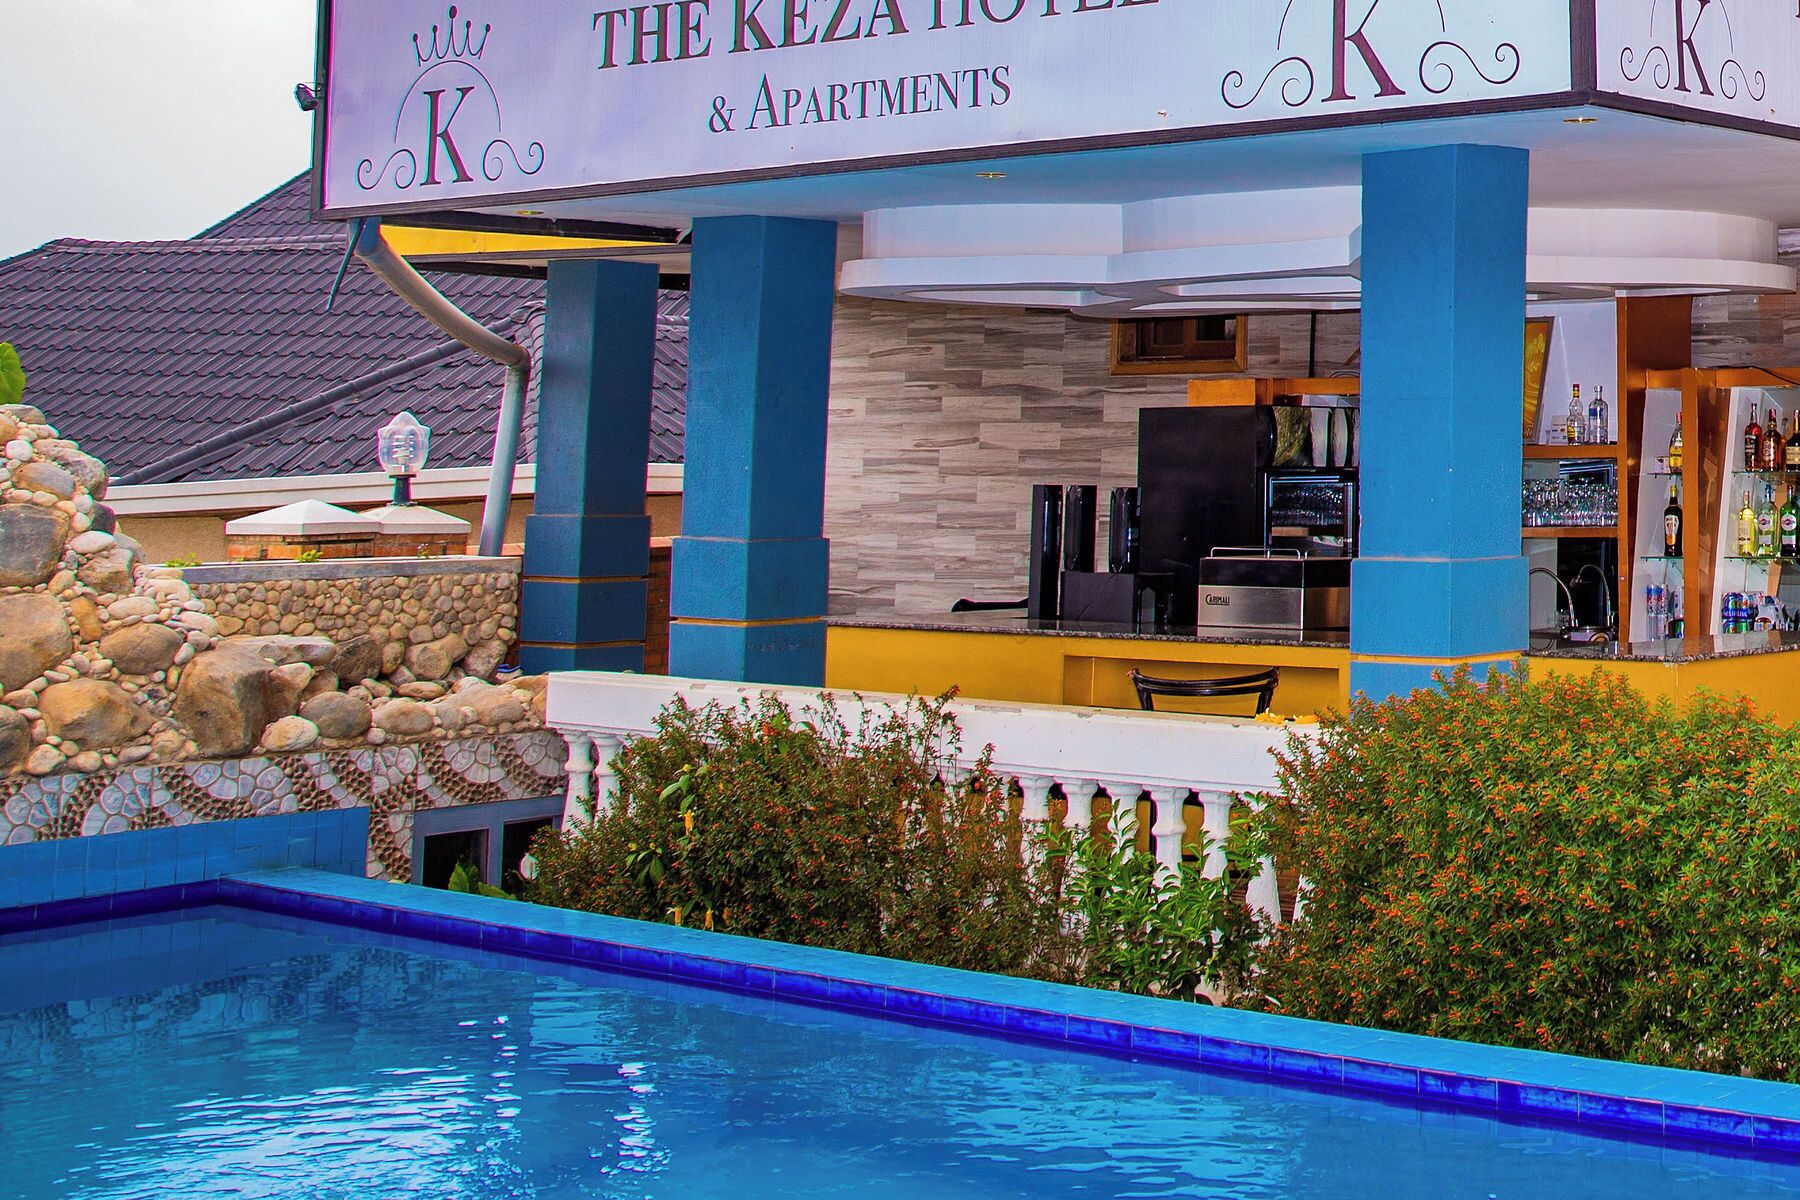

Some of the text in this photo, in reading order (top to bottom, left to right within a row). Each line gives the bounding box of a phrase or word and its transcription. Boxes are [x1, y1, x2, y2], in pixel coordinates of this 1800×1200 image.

[420, 85, 475, 186] K
[708, 65, 1012, 133] & APARTMENTS
